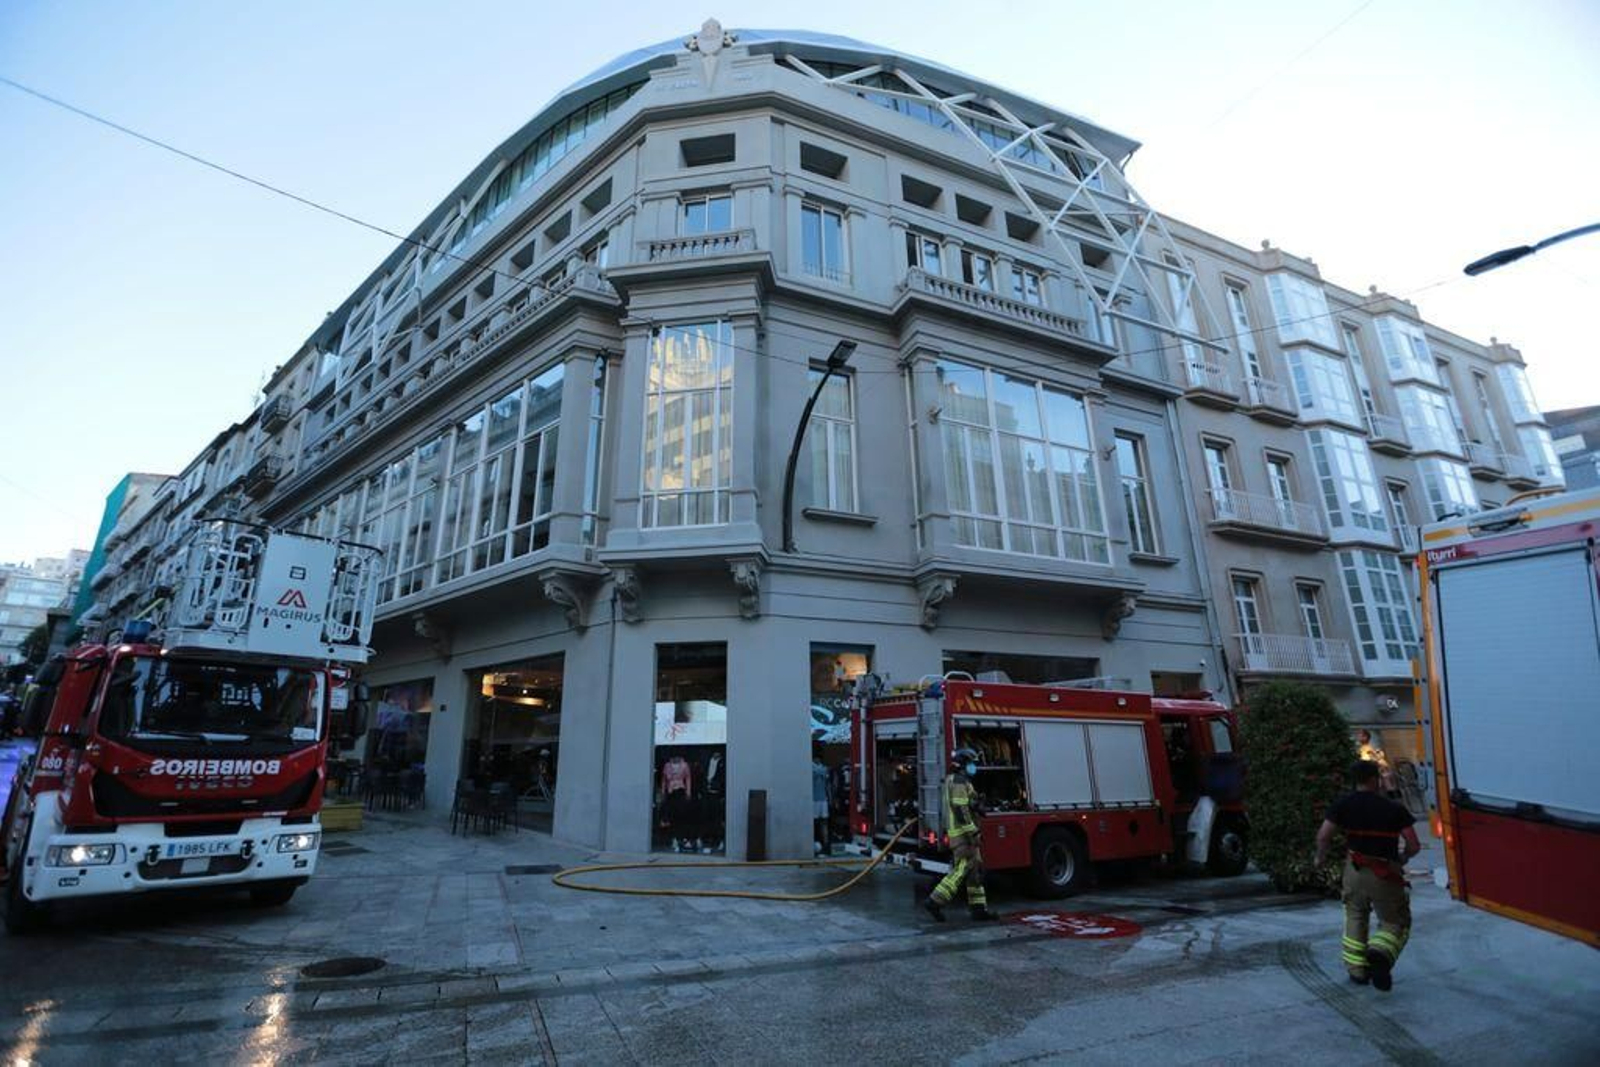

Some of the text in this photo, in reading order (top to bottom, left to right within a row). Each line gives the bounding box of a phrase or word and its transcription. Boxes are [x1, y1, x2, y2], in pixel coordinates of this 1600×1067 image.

[256, 606, 322, 623] MAGIRUS
[175, 775, 254, 790] IVECO
[178, 840, 232, 854] 1985 LFK
